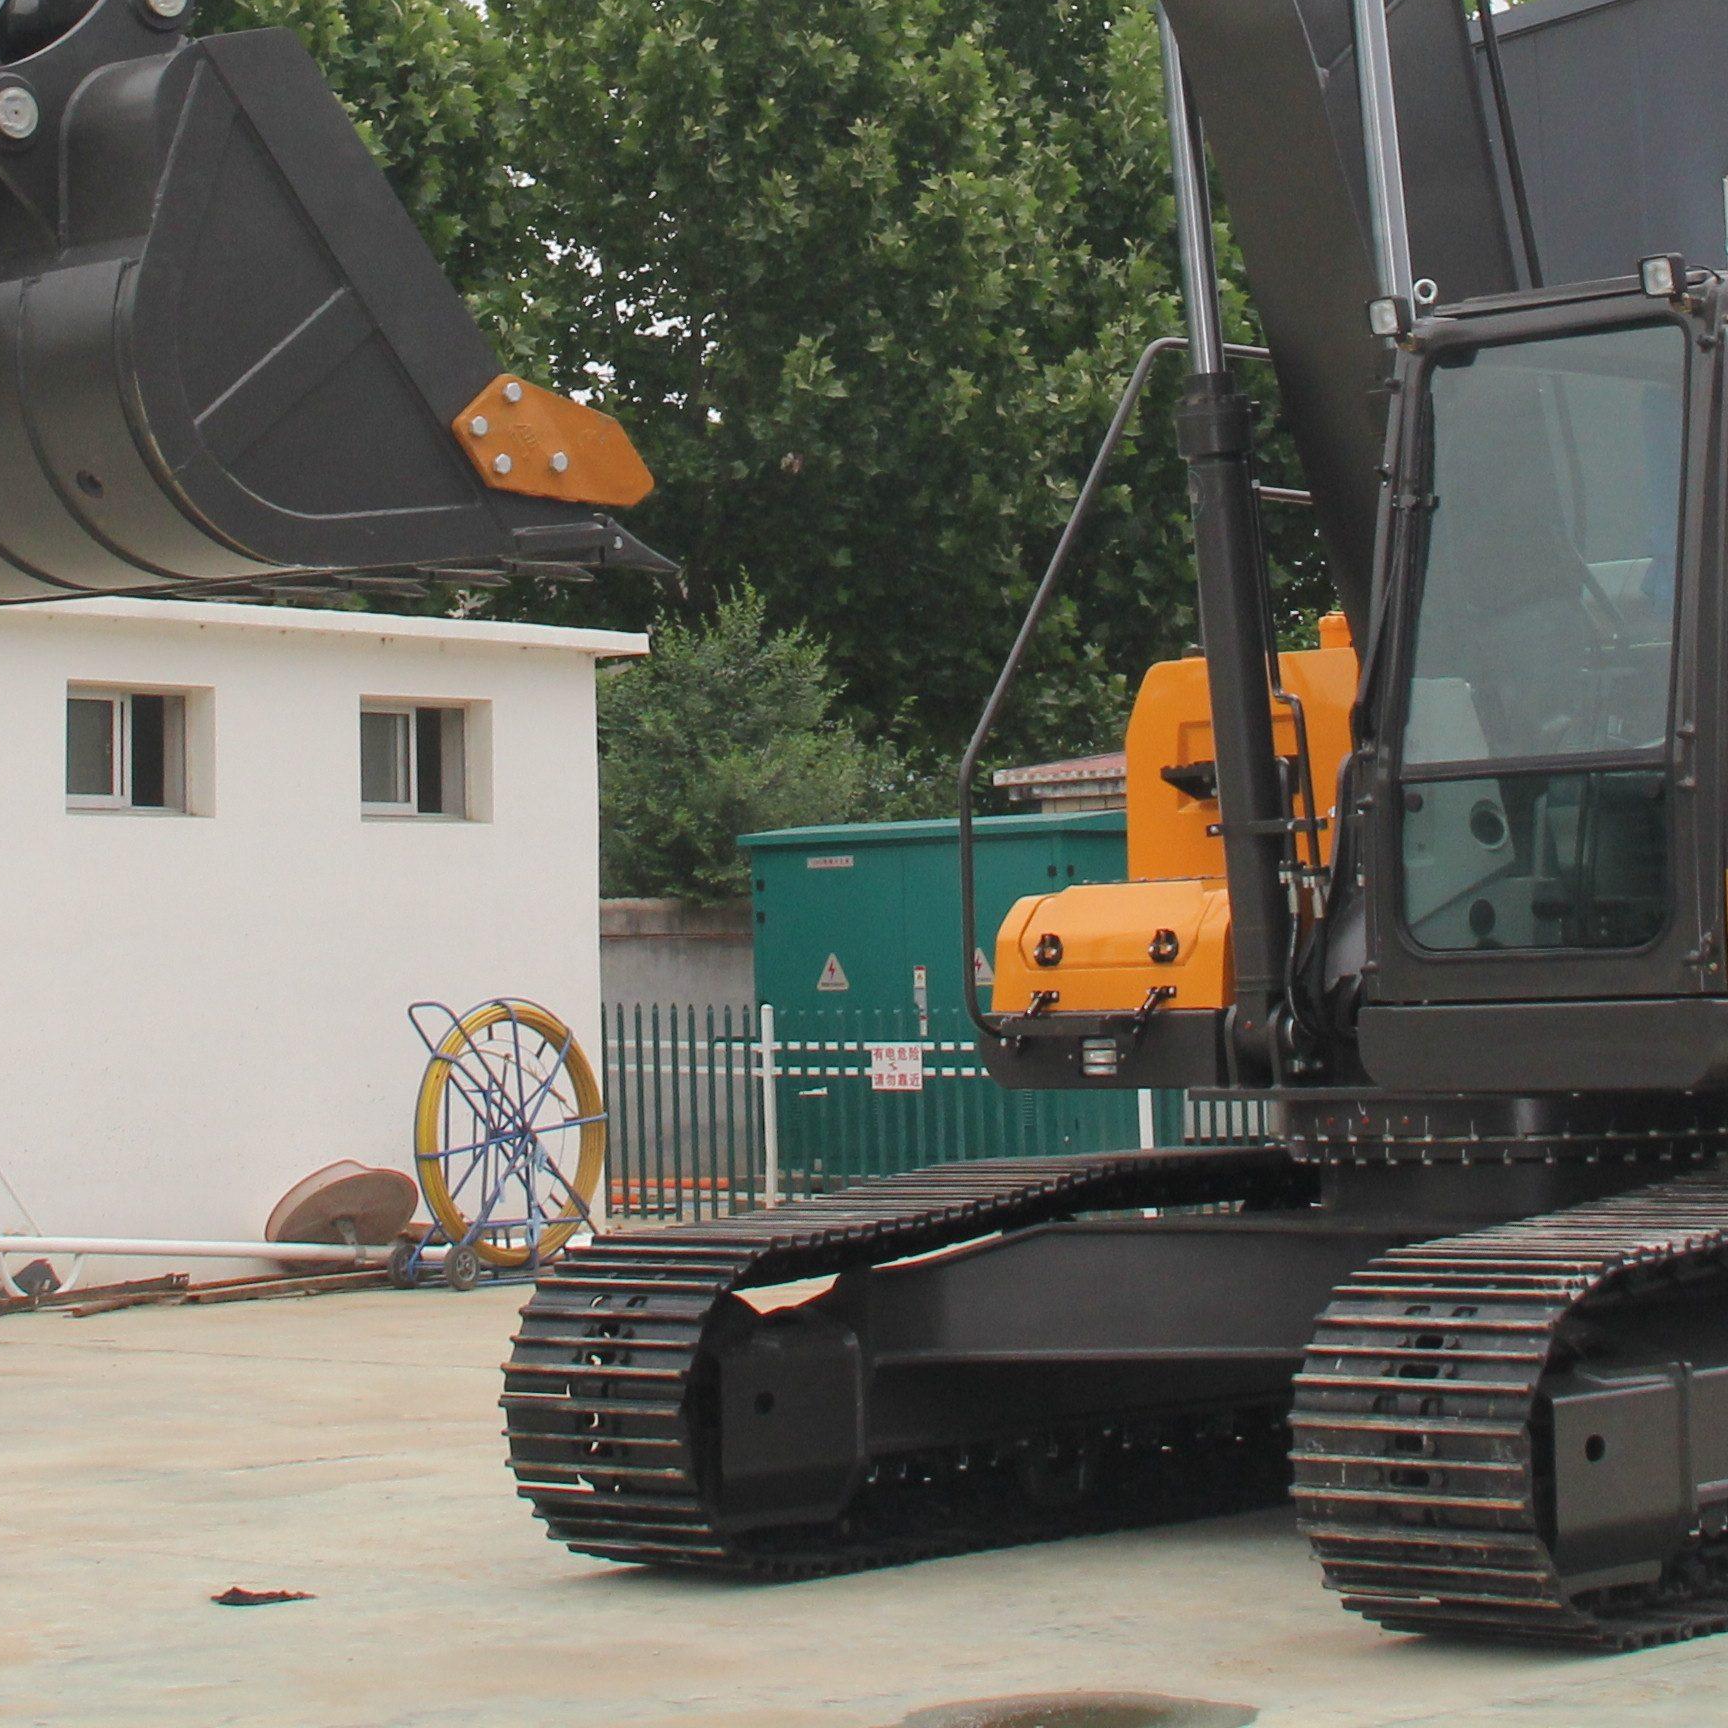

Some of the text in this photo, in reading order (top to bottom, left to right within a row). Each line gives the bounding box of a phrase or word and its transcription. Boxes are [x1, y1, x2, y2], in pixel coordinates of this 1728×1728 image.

[873, 1046, 919, 1060] 有电危险
[874, 1073, 920, 1086] 请勿靠近
